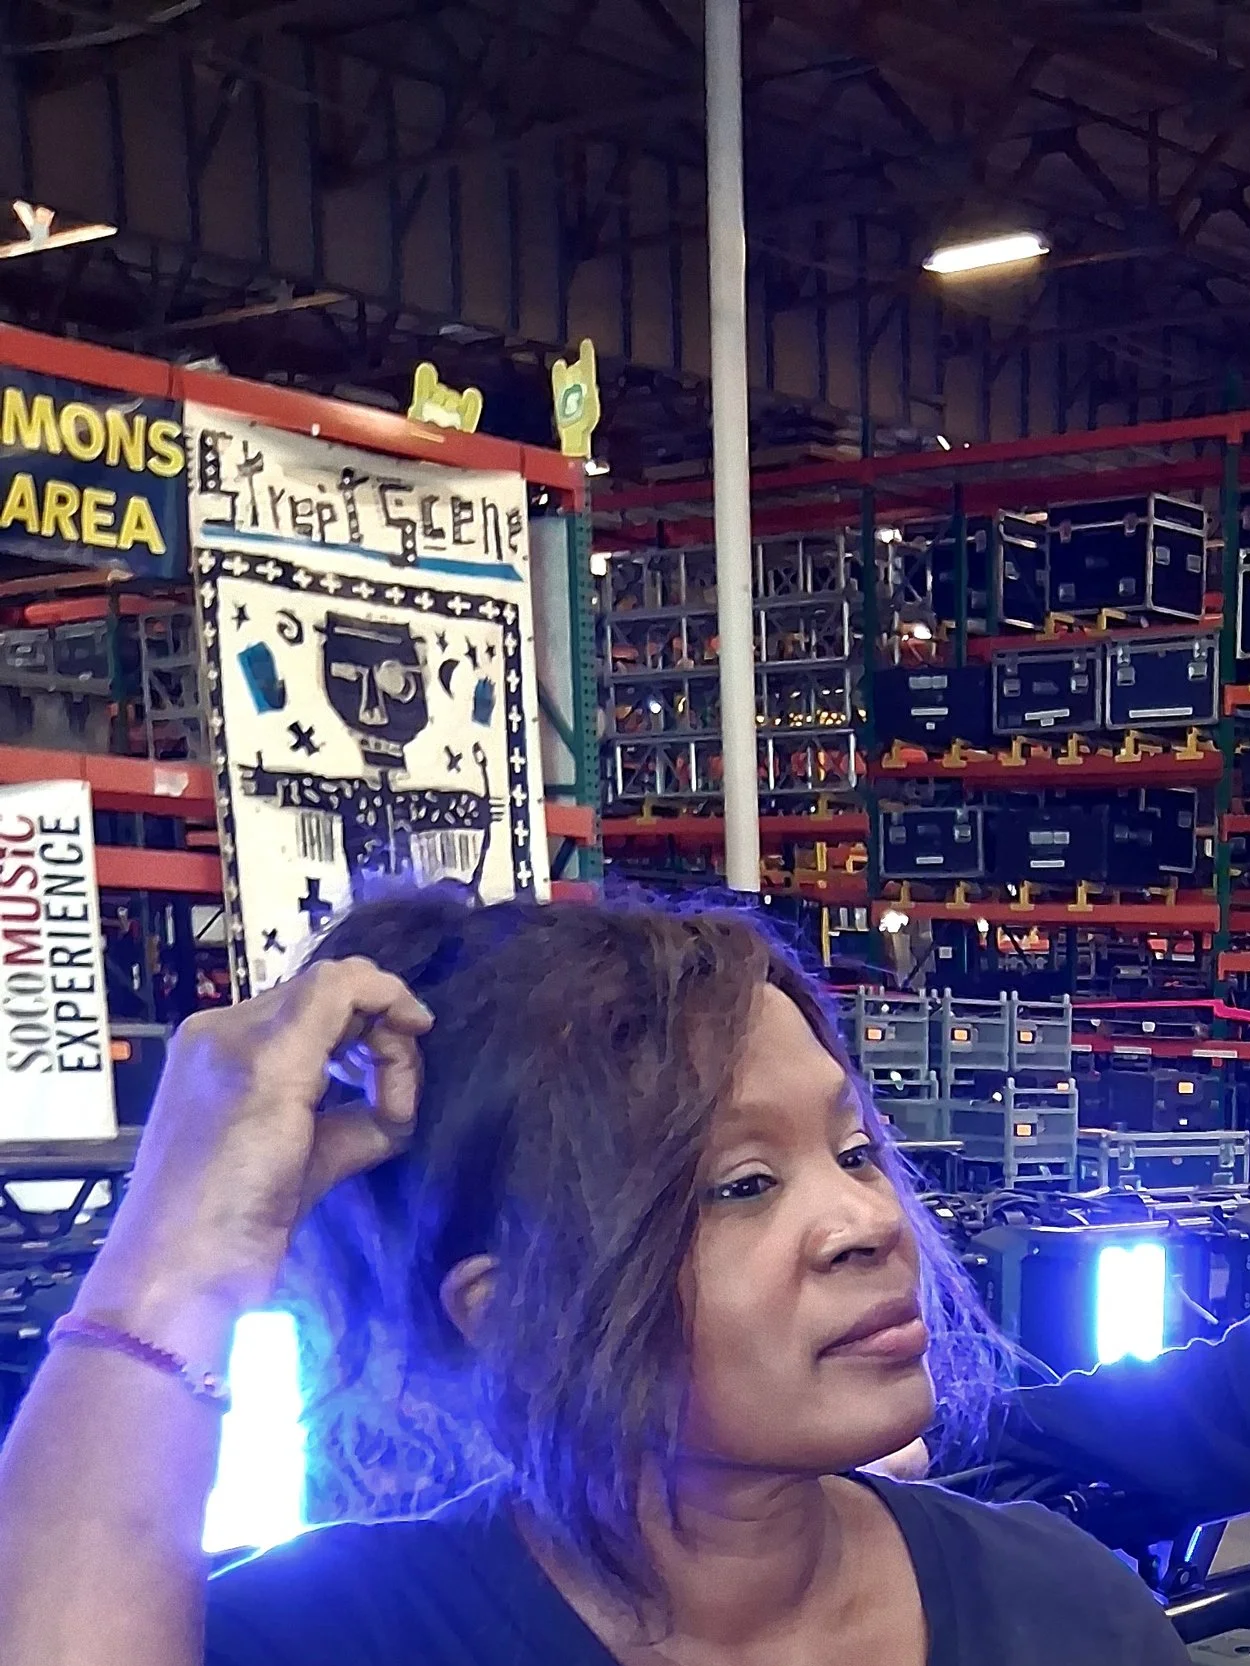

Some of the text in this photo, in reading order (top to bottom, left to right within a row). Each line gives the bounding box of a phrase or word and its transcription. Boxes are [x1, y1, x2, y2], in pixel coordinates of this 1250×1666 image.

[2, 386, 186, 478] MONS
[0, 472, 167, 555] AREA
[39, 815, 103, 1075] EXPERIENCE
